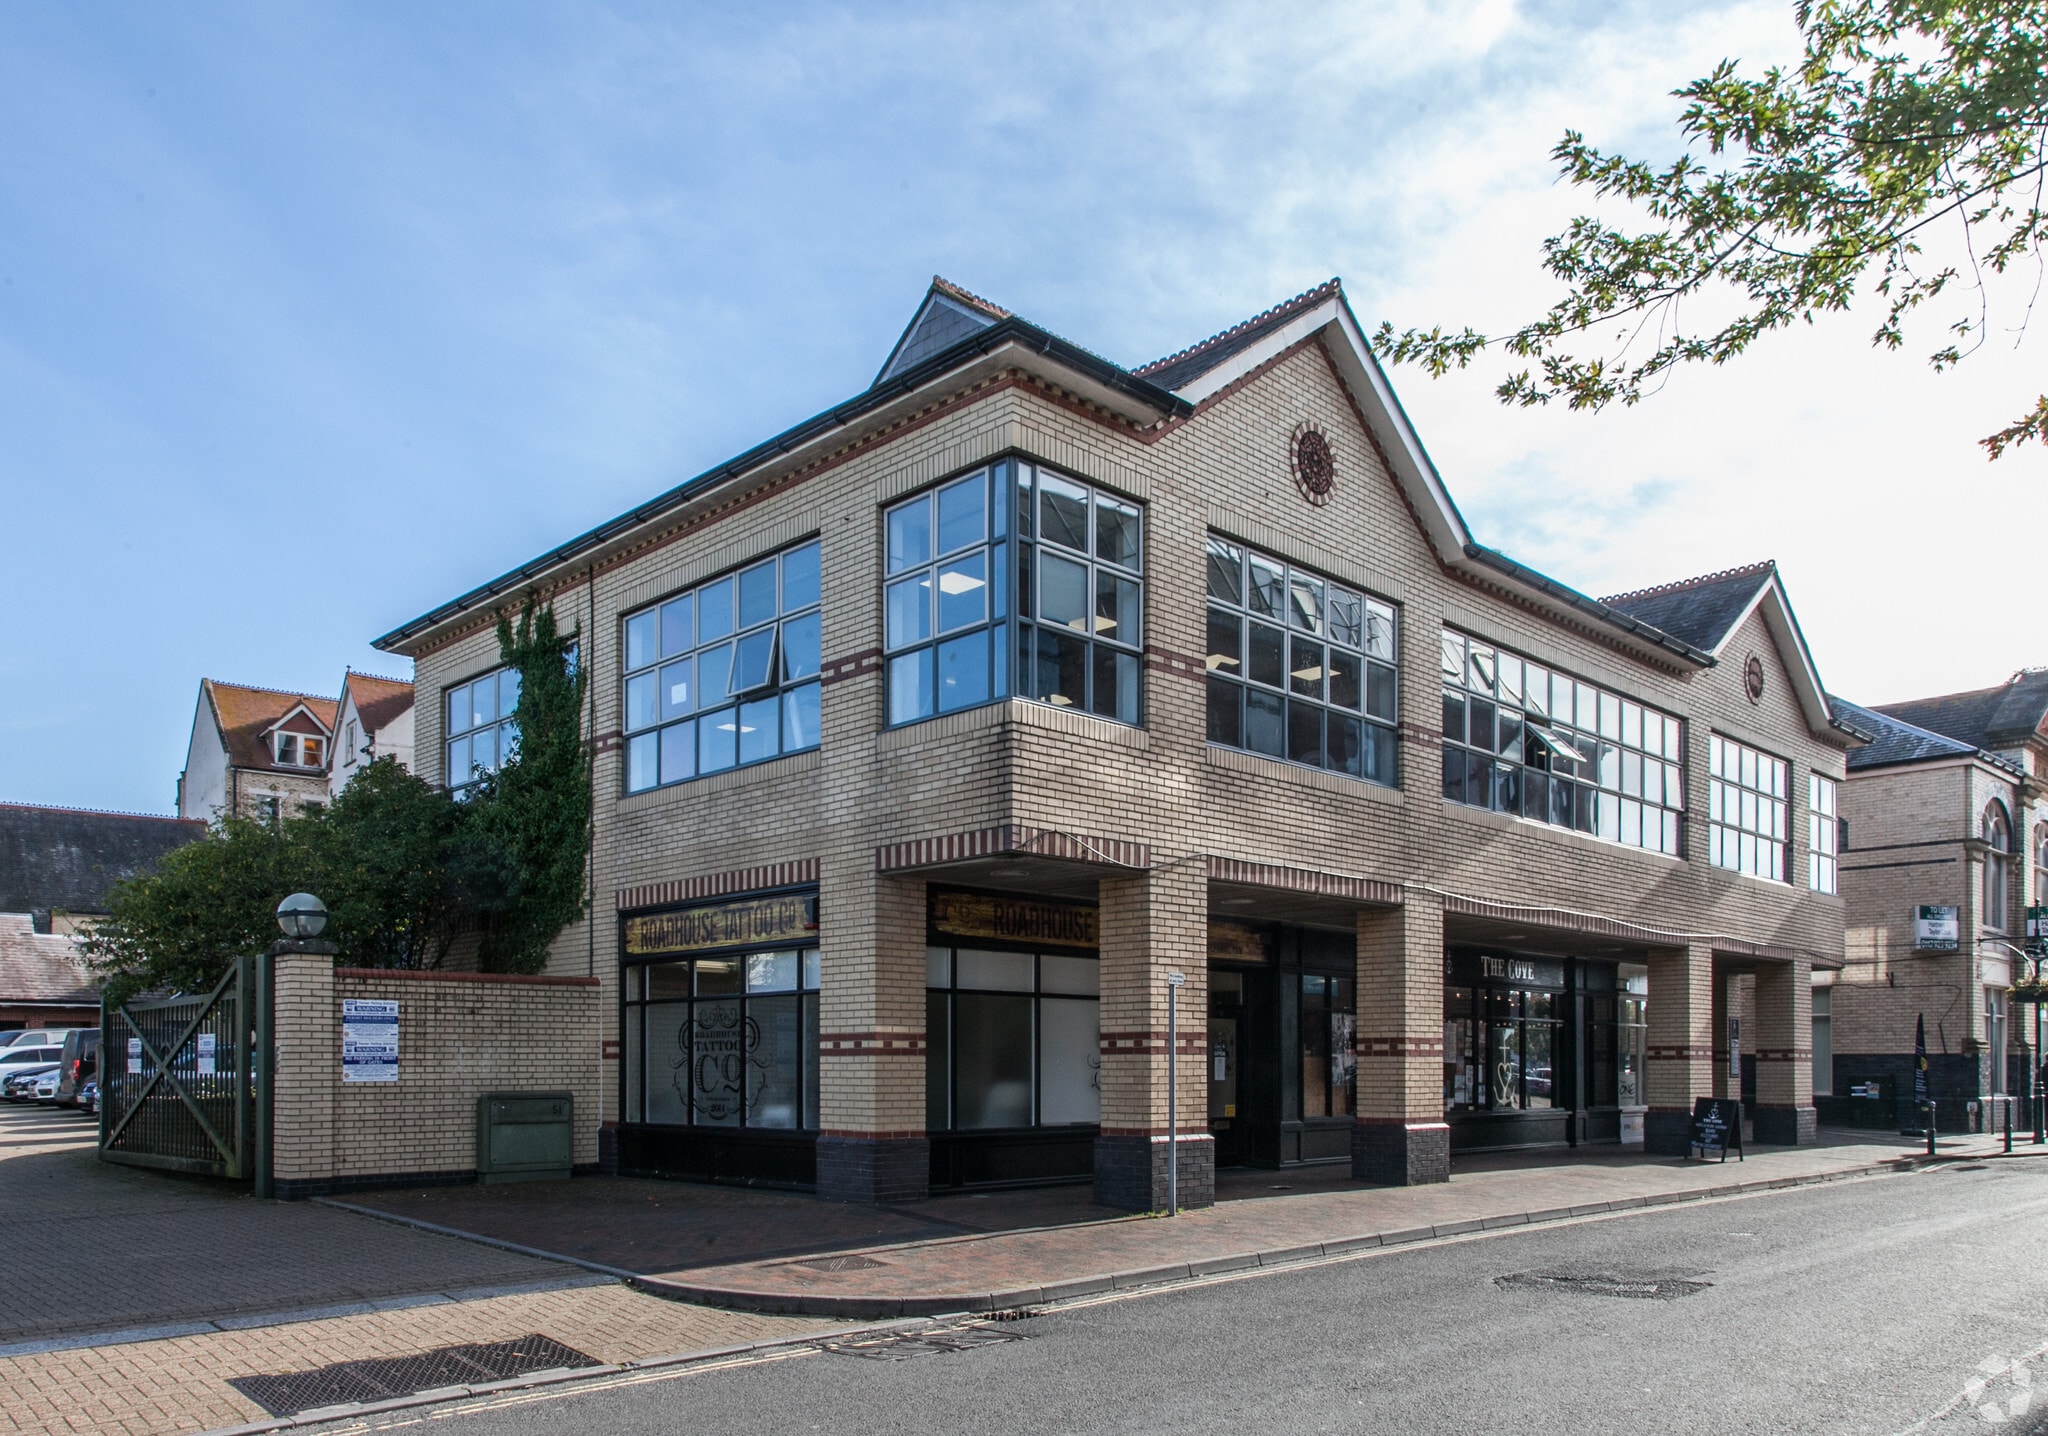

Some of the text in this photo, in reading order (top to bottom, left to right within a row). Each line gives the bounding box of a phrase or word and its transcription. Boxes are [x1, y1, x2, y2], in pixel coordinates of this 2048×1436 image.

[992, 902, 1094, 943] ROADHOUSE
[1930, 906, 1948, 914] TO LET
[640, 912, 718, 951] ROADHOUSE
[724, 906, 775, 941] TATTOO
[1481, 956, 1535, 980] THE COVE
